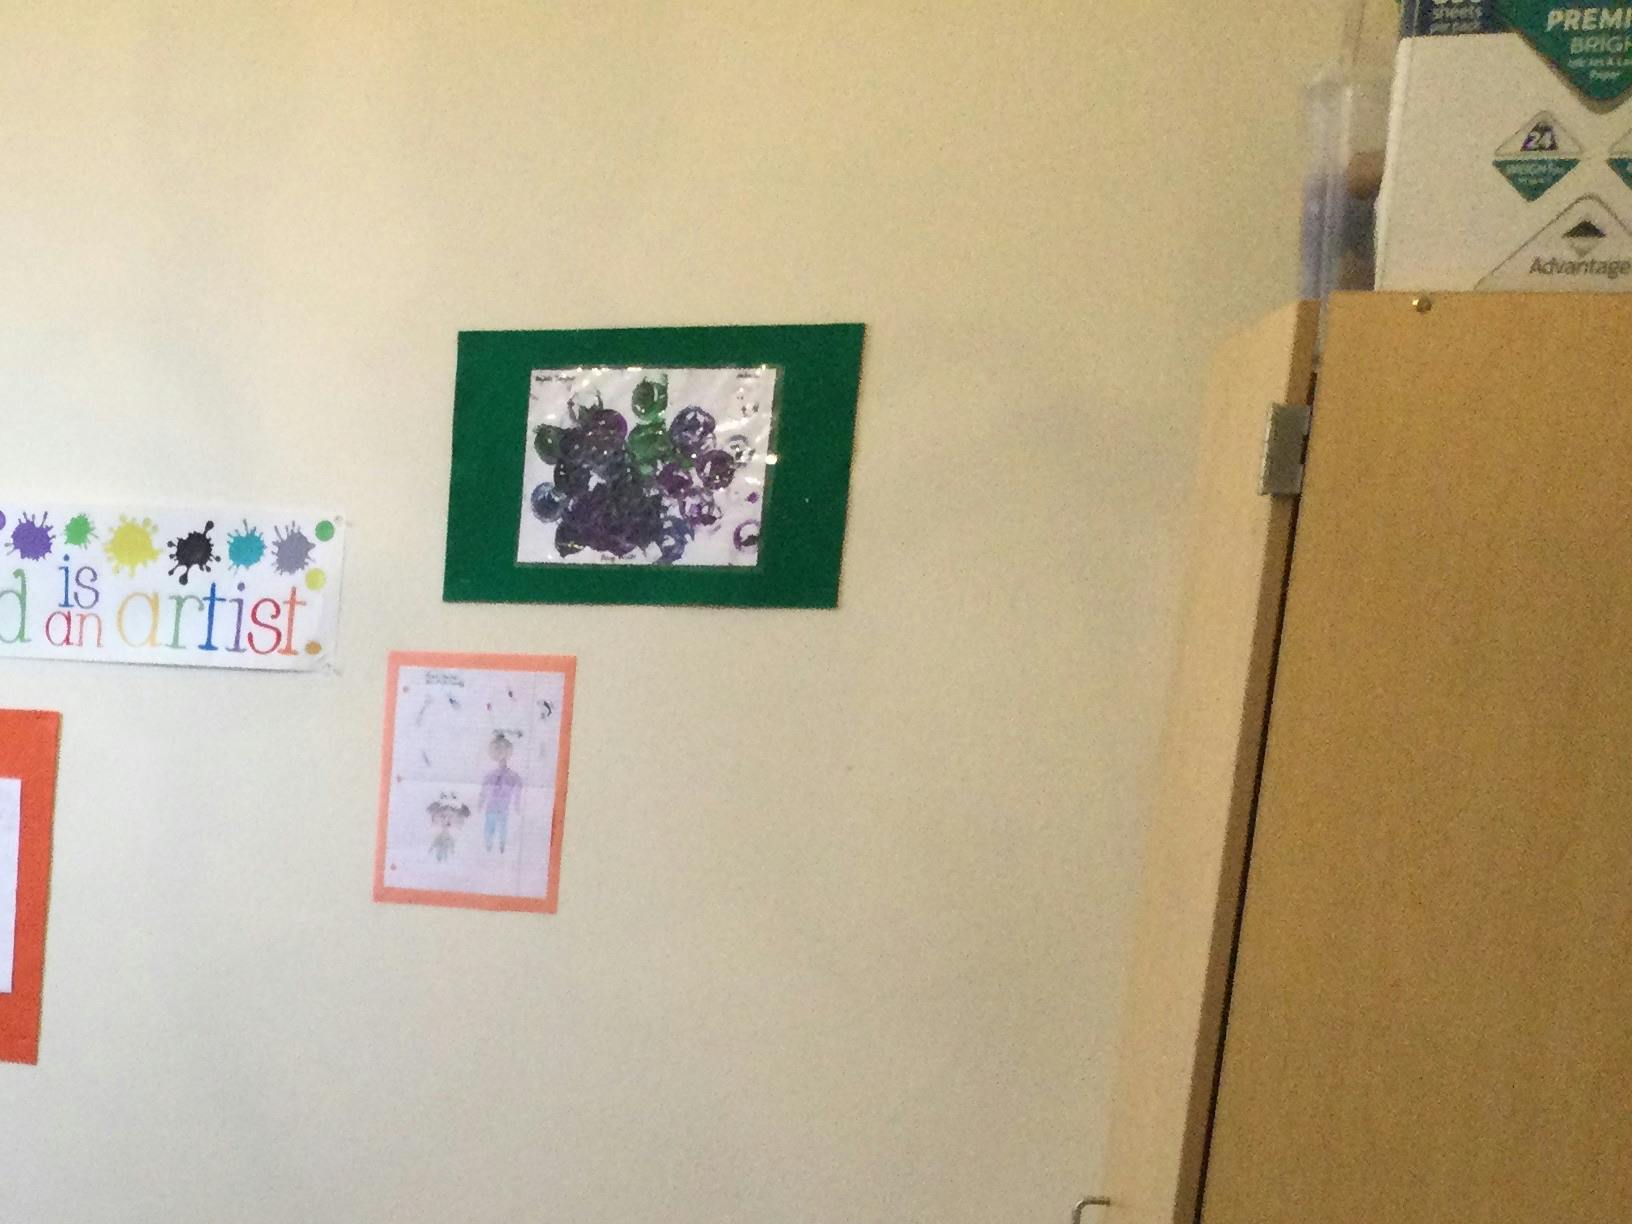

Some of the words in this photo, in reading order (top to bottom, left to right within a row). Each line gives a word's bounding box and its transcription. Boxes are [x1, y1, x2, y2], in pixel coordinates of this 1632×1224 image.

[1529, 256, 1631, 279] Advantage
[58, 553, 100, 609] is
[45, 611, 103, 648] an
